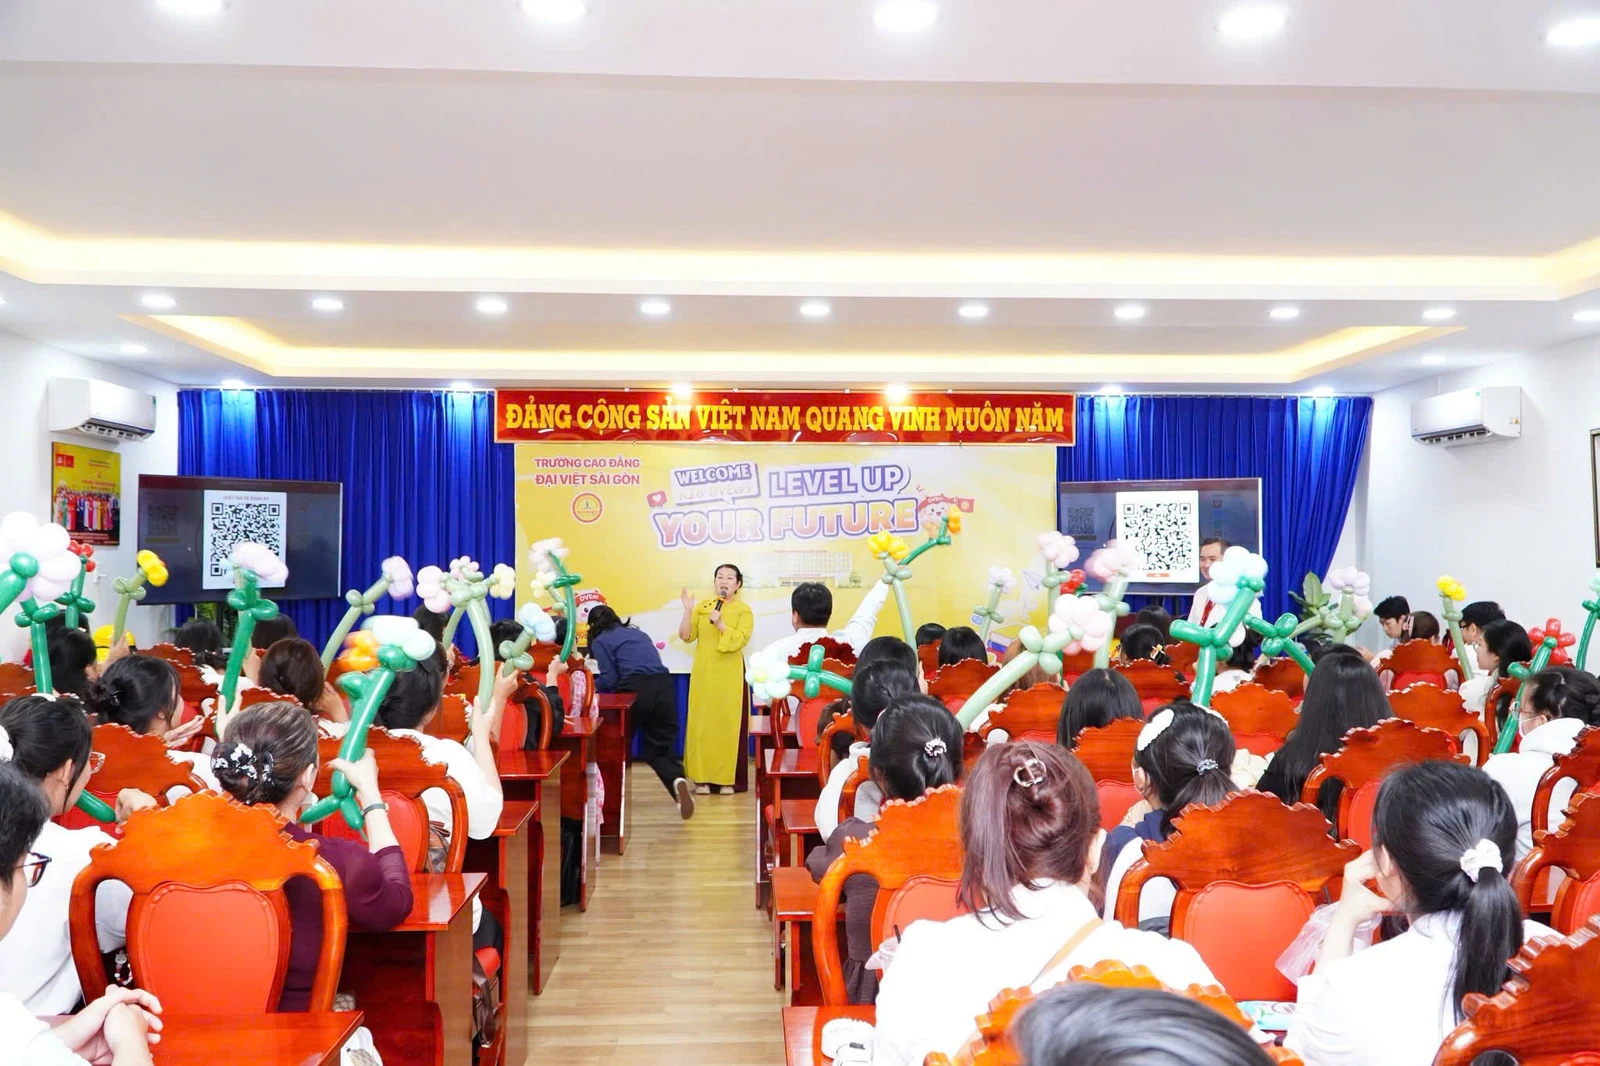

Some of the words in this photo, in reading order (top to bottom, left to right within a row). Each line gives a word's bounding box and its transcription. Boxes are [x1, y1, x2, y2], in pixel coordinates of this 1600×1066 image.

[505, 395, 572, 430] ĐẢNG
[576, 398, 641, 435] CỘNG
[646, 396, 692, 430] SẢN
[696, 398, 746, 435] VIỆT
[750, 404, 800, 431] NAM
[805, 405, 885, 432] QUANG
[888, 405, 941, 432] VINH
[945, 400, 1010, 432] MUÔN
[1015, 401, 1064, 433] NĂM
[534, 456, 582, 468] TRƯỜNG
[583, 458, 607, 468] CAO
[674, 463, 752, 487] WELCOME
[535, 474, 557, 487] ĐẠI
[559, 472, 587, 487] VIỆT
[589, 472, 610, 485] SÀI
[612, 472, 640, 485] GÒN
[769, 467, 858, 498] LEVEL
[861, 464, 903, 492] UP
[653, 507, 765, 547] YOUR
[769, 497, 919, 541] FUTURE
